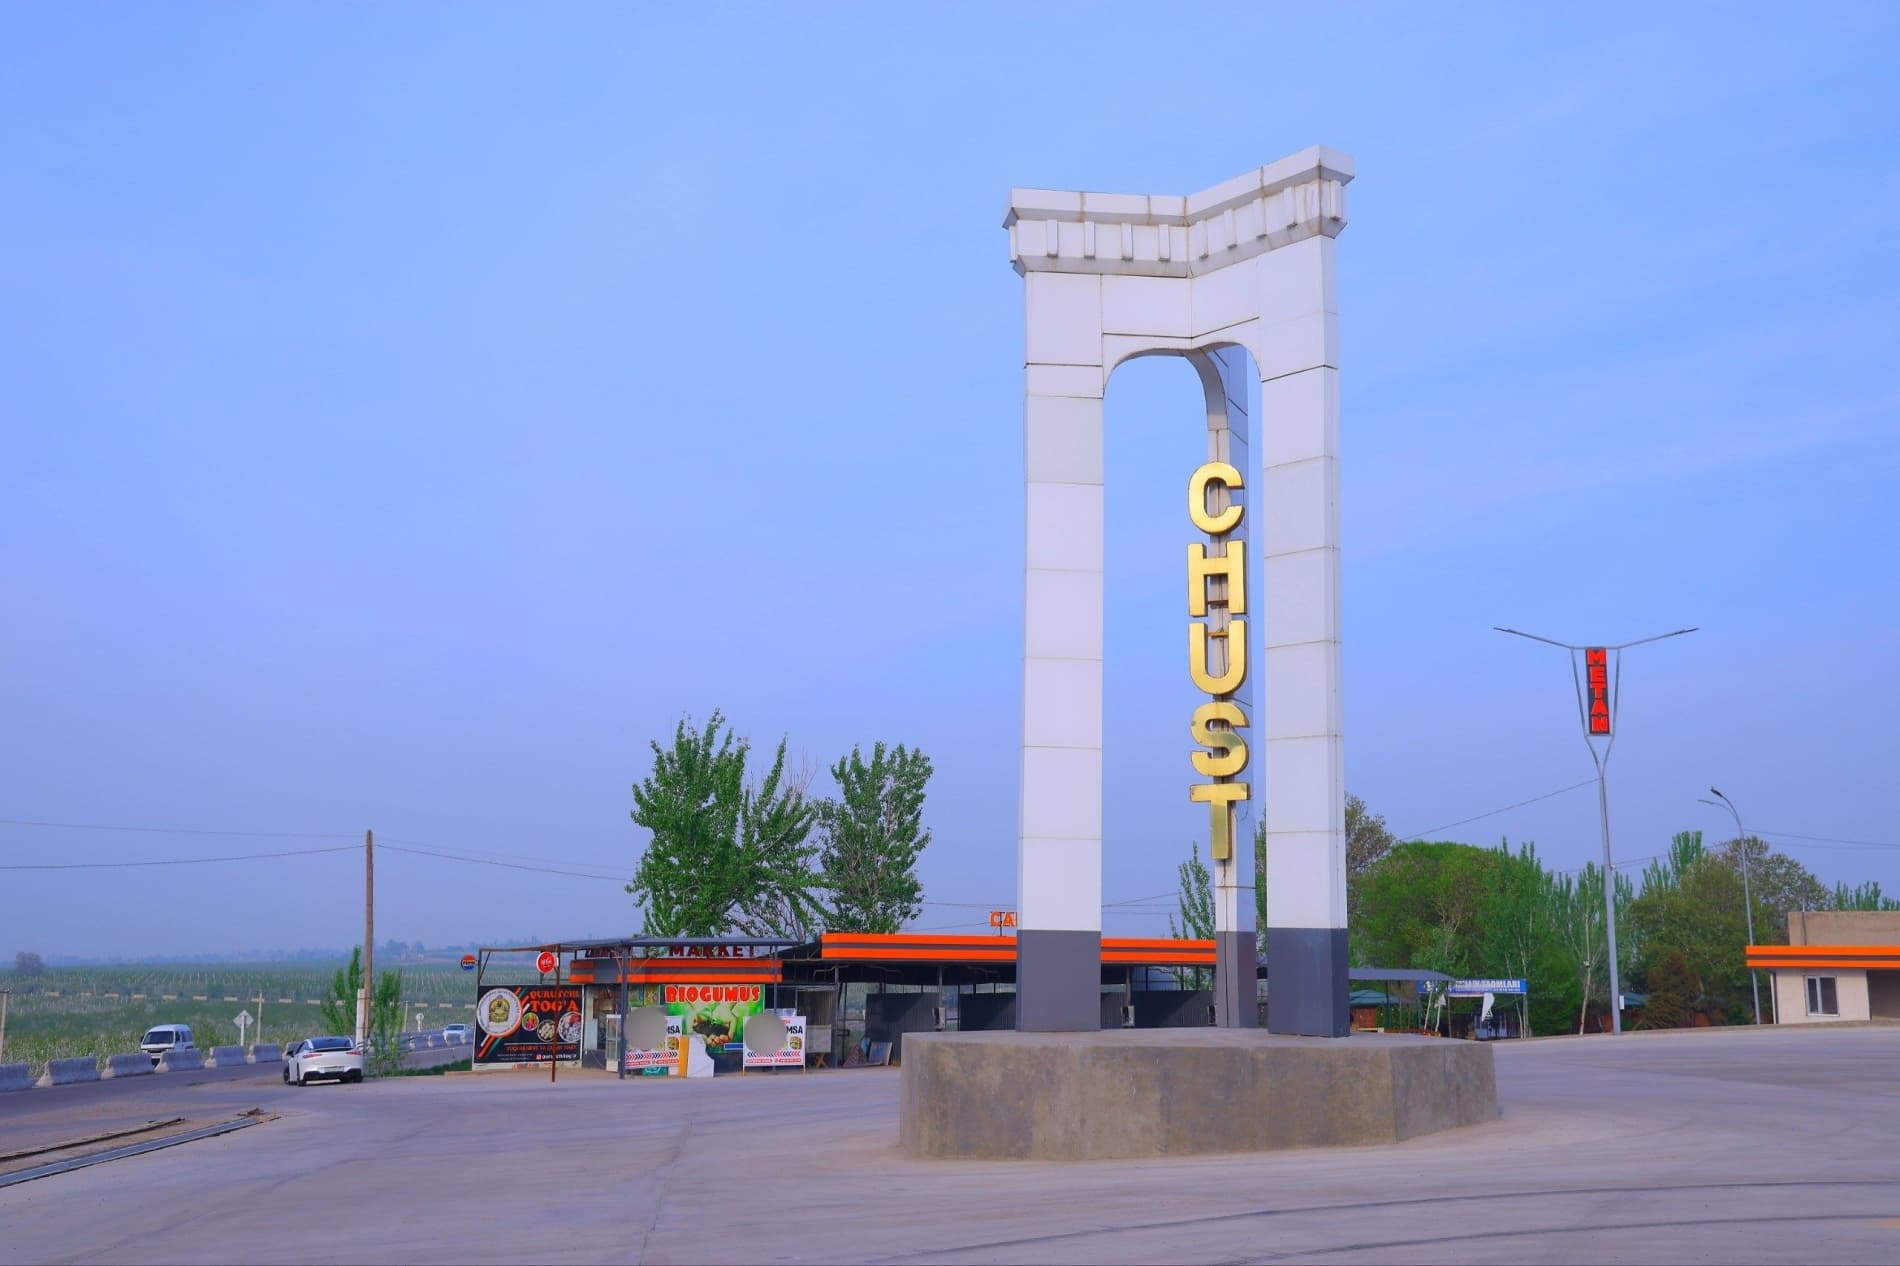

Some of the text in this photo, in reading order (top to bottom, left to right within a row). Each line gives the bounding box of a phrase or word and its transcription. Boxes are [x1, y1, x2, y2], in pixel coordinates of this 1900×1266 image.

[1187, 461, 1251, 860] CHUST
[1586, 649, 1609, 732] METAN
[990, 911, 1018, 928] CA
[665, 986, 760, 1003] BIOGUMUS
